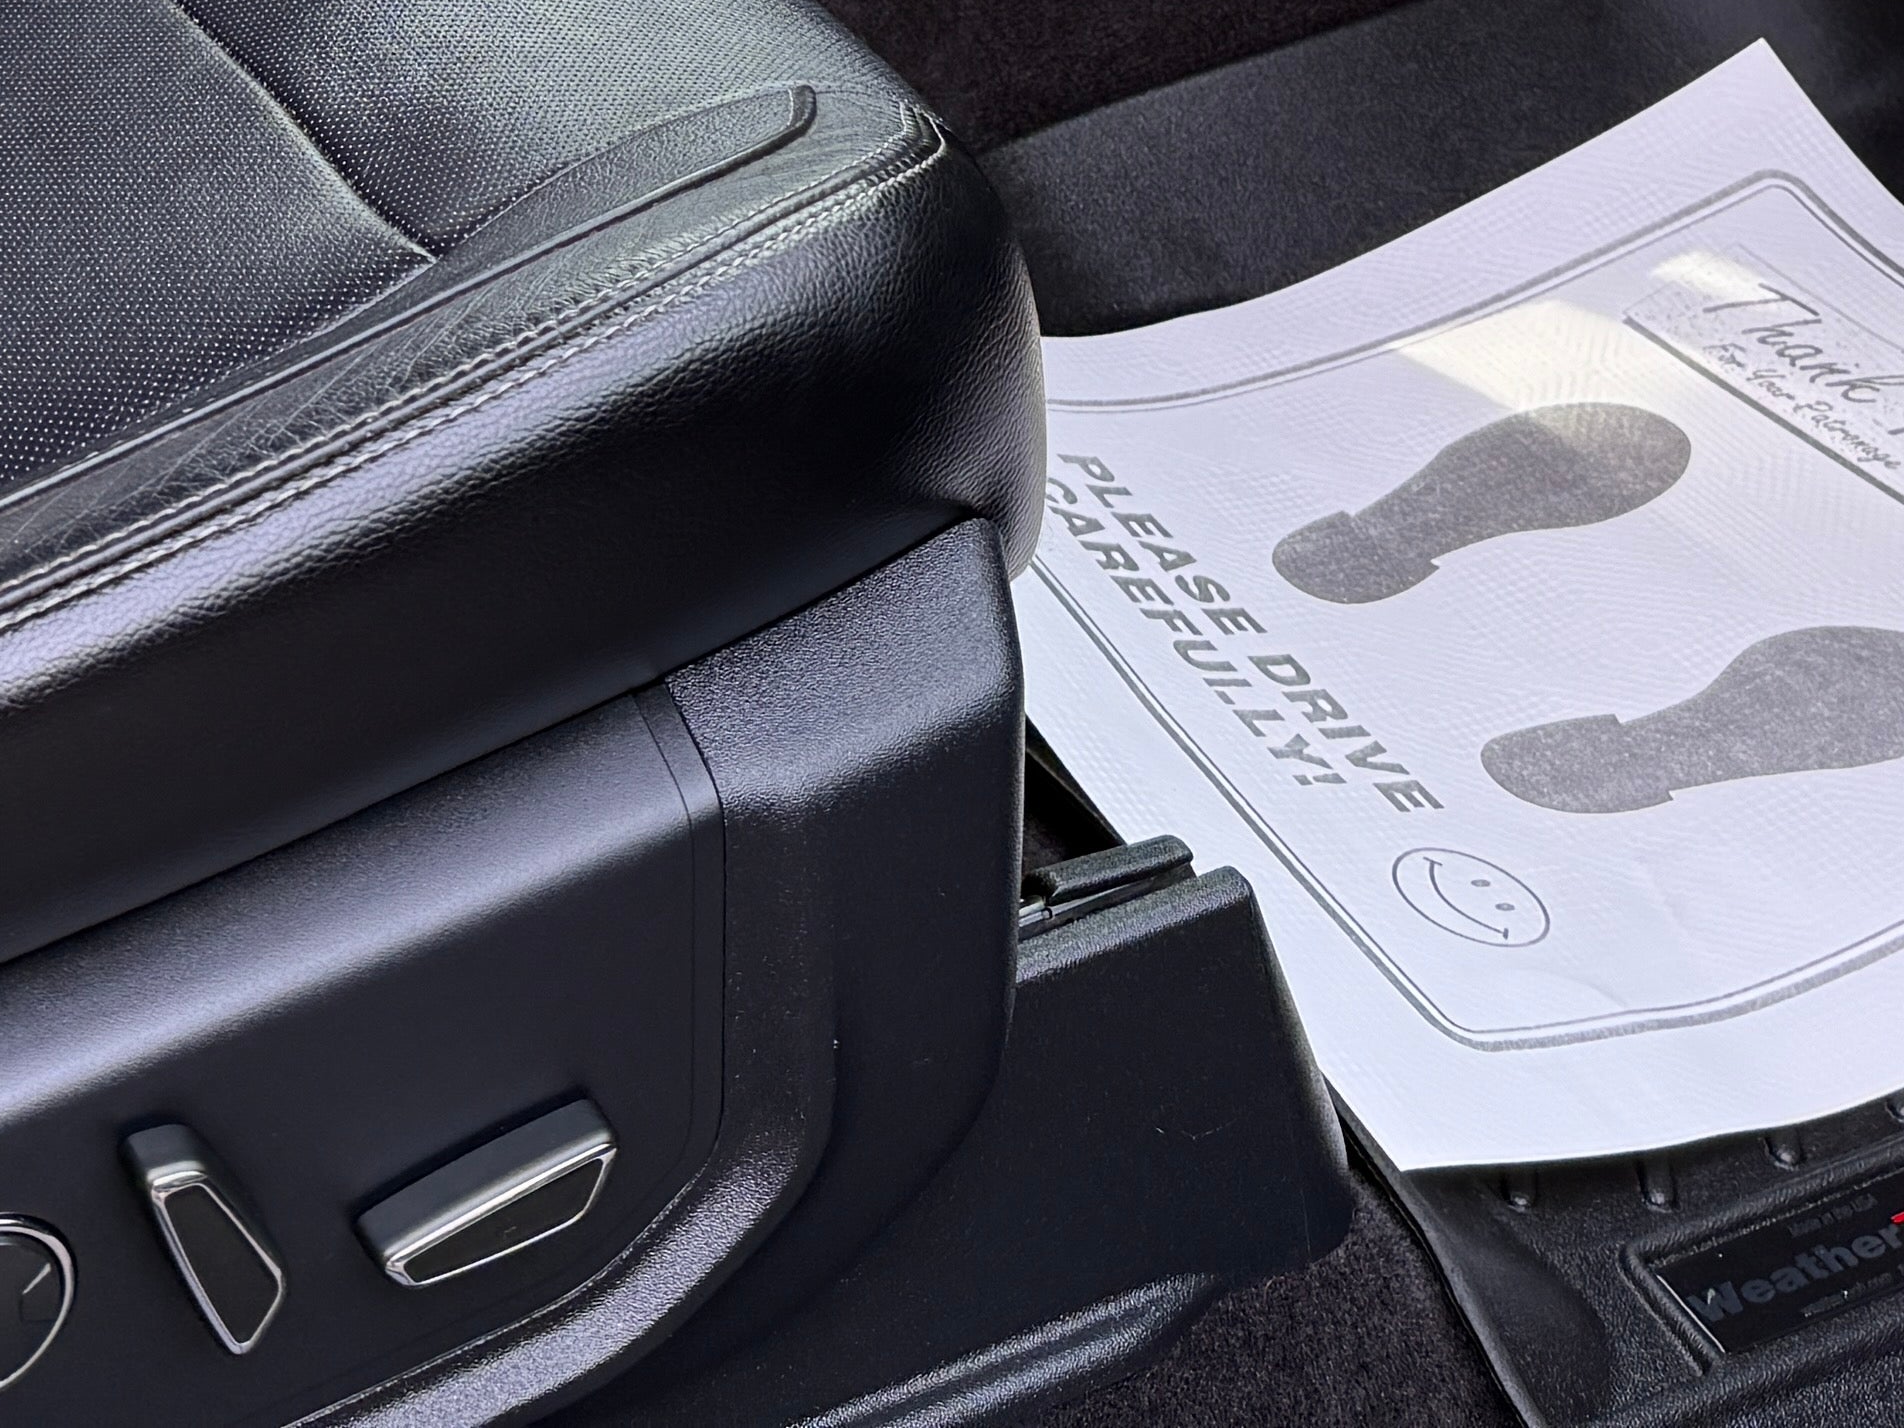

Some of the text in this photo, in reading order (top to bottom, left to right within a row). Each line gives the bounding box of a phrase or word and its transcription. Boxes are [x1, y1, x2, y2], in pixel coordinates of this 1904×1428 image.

[1704, 342, 1899, 470] For Your Patronage
[1043, 475, 1348, 788] CAREFULLY!
[1057, 453, 1445, 813] PLEASE DRIVE
